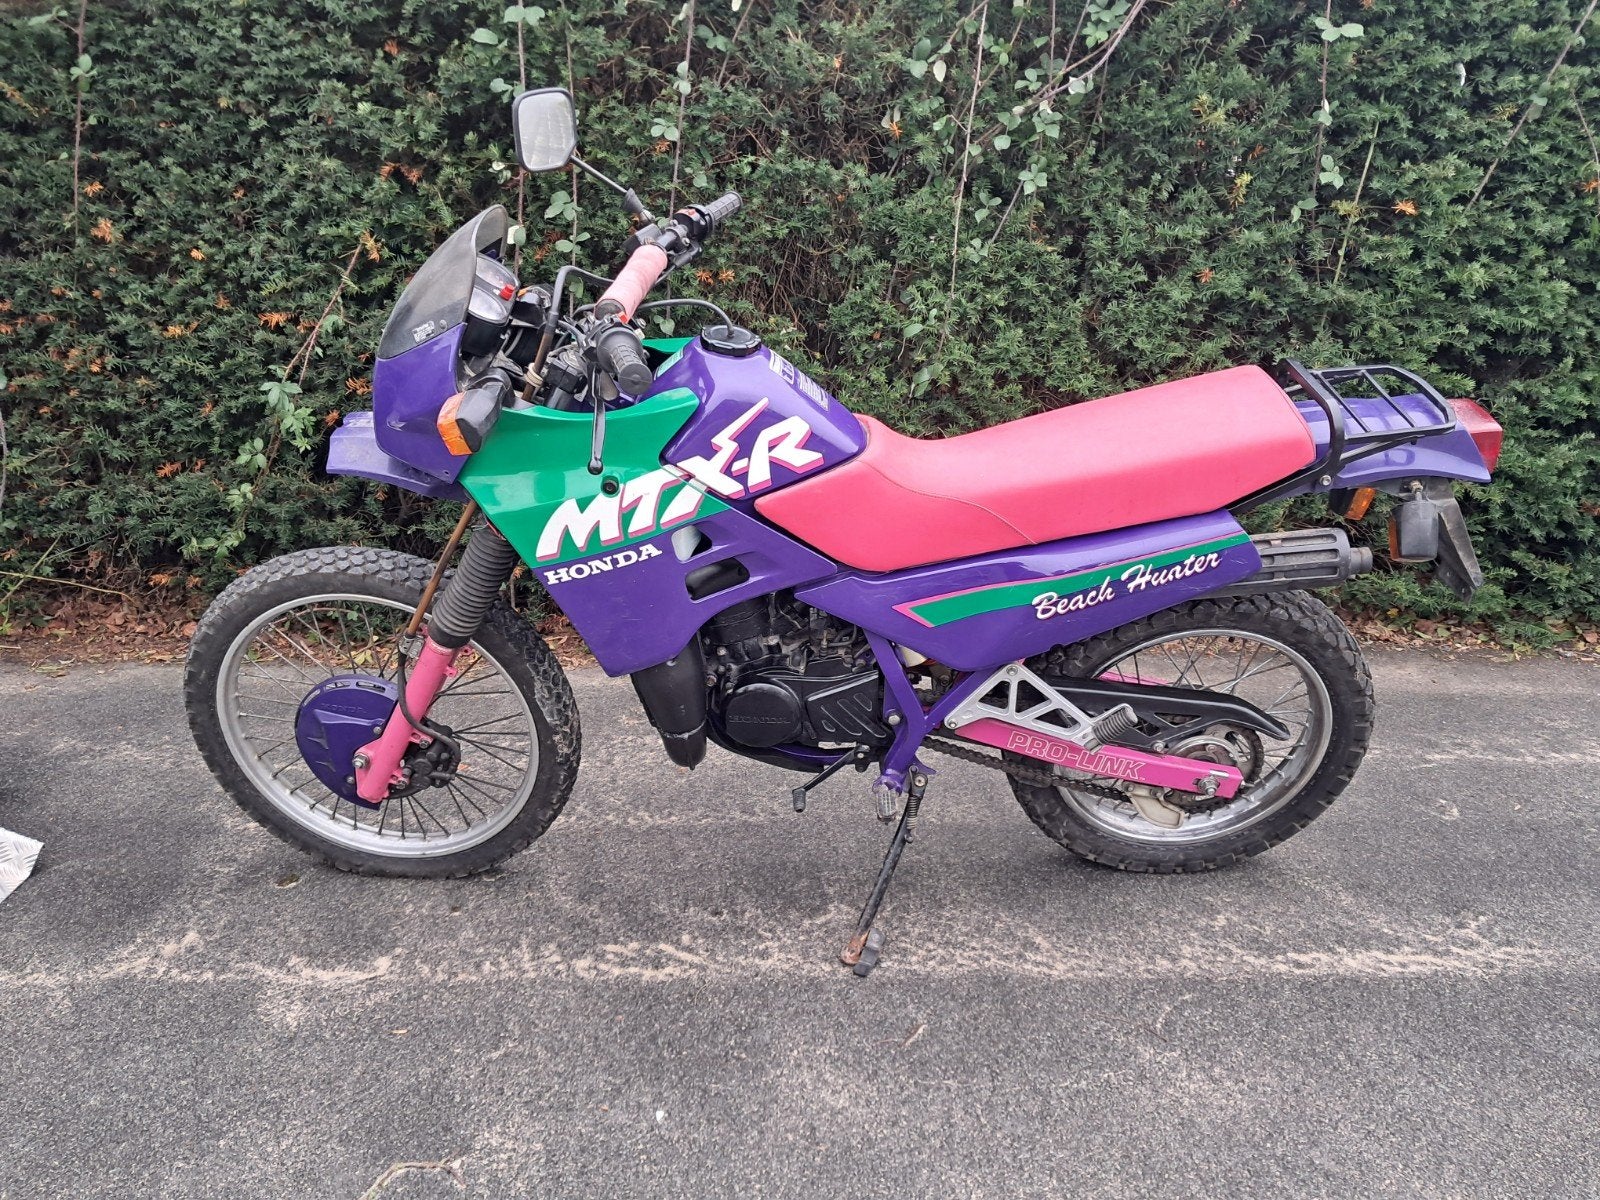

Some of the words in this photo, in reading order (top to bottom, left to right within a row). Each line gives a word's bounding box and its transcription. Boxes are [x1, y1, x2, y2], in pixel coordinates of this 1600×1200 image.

[535, 397, 824, 562] MTX-R
[543, 543, 662, 585] HONDA
[1031, 575, 1115, 620] Beach
[1120, 552, 1220, 593] Hunter
[728, 713, 791, 724] HONDA
[1007, 730, 1144, 780] PRO-LINK
